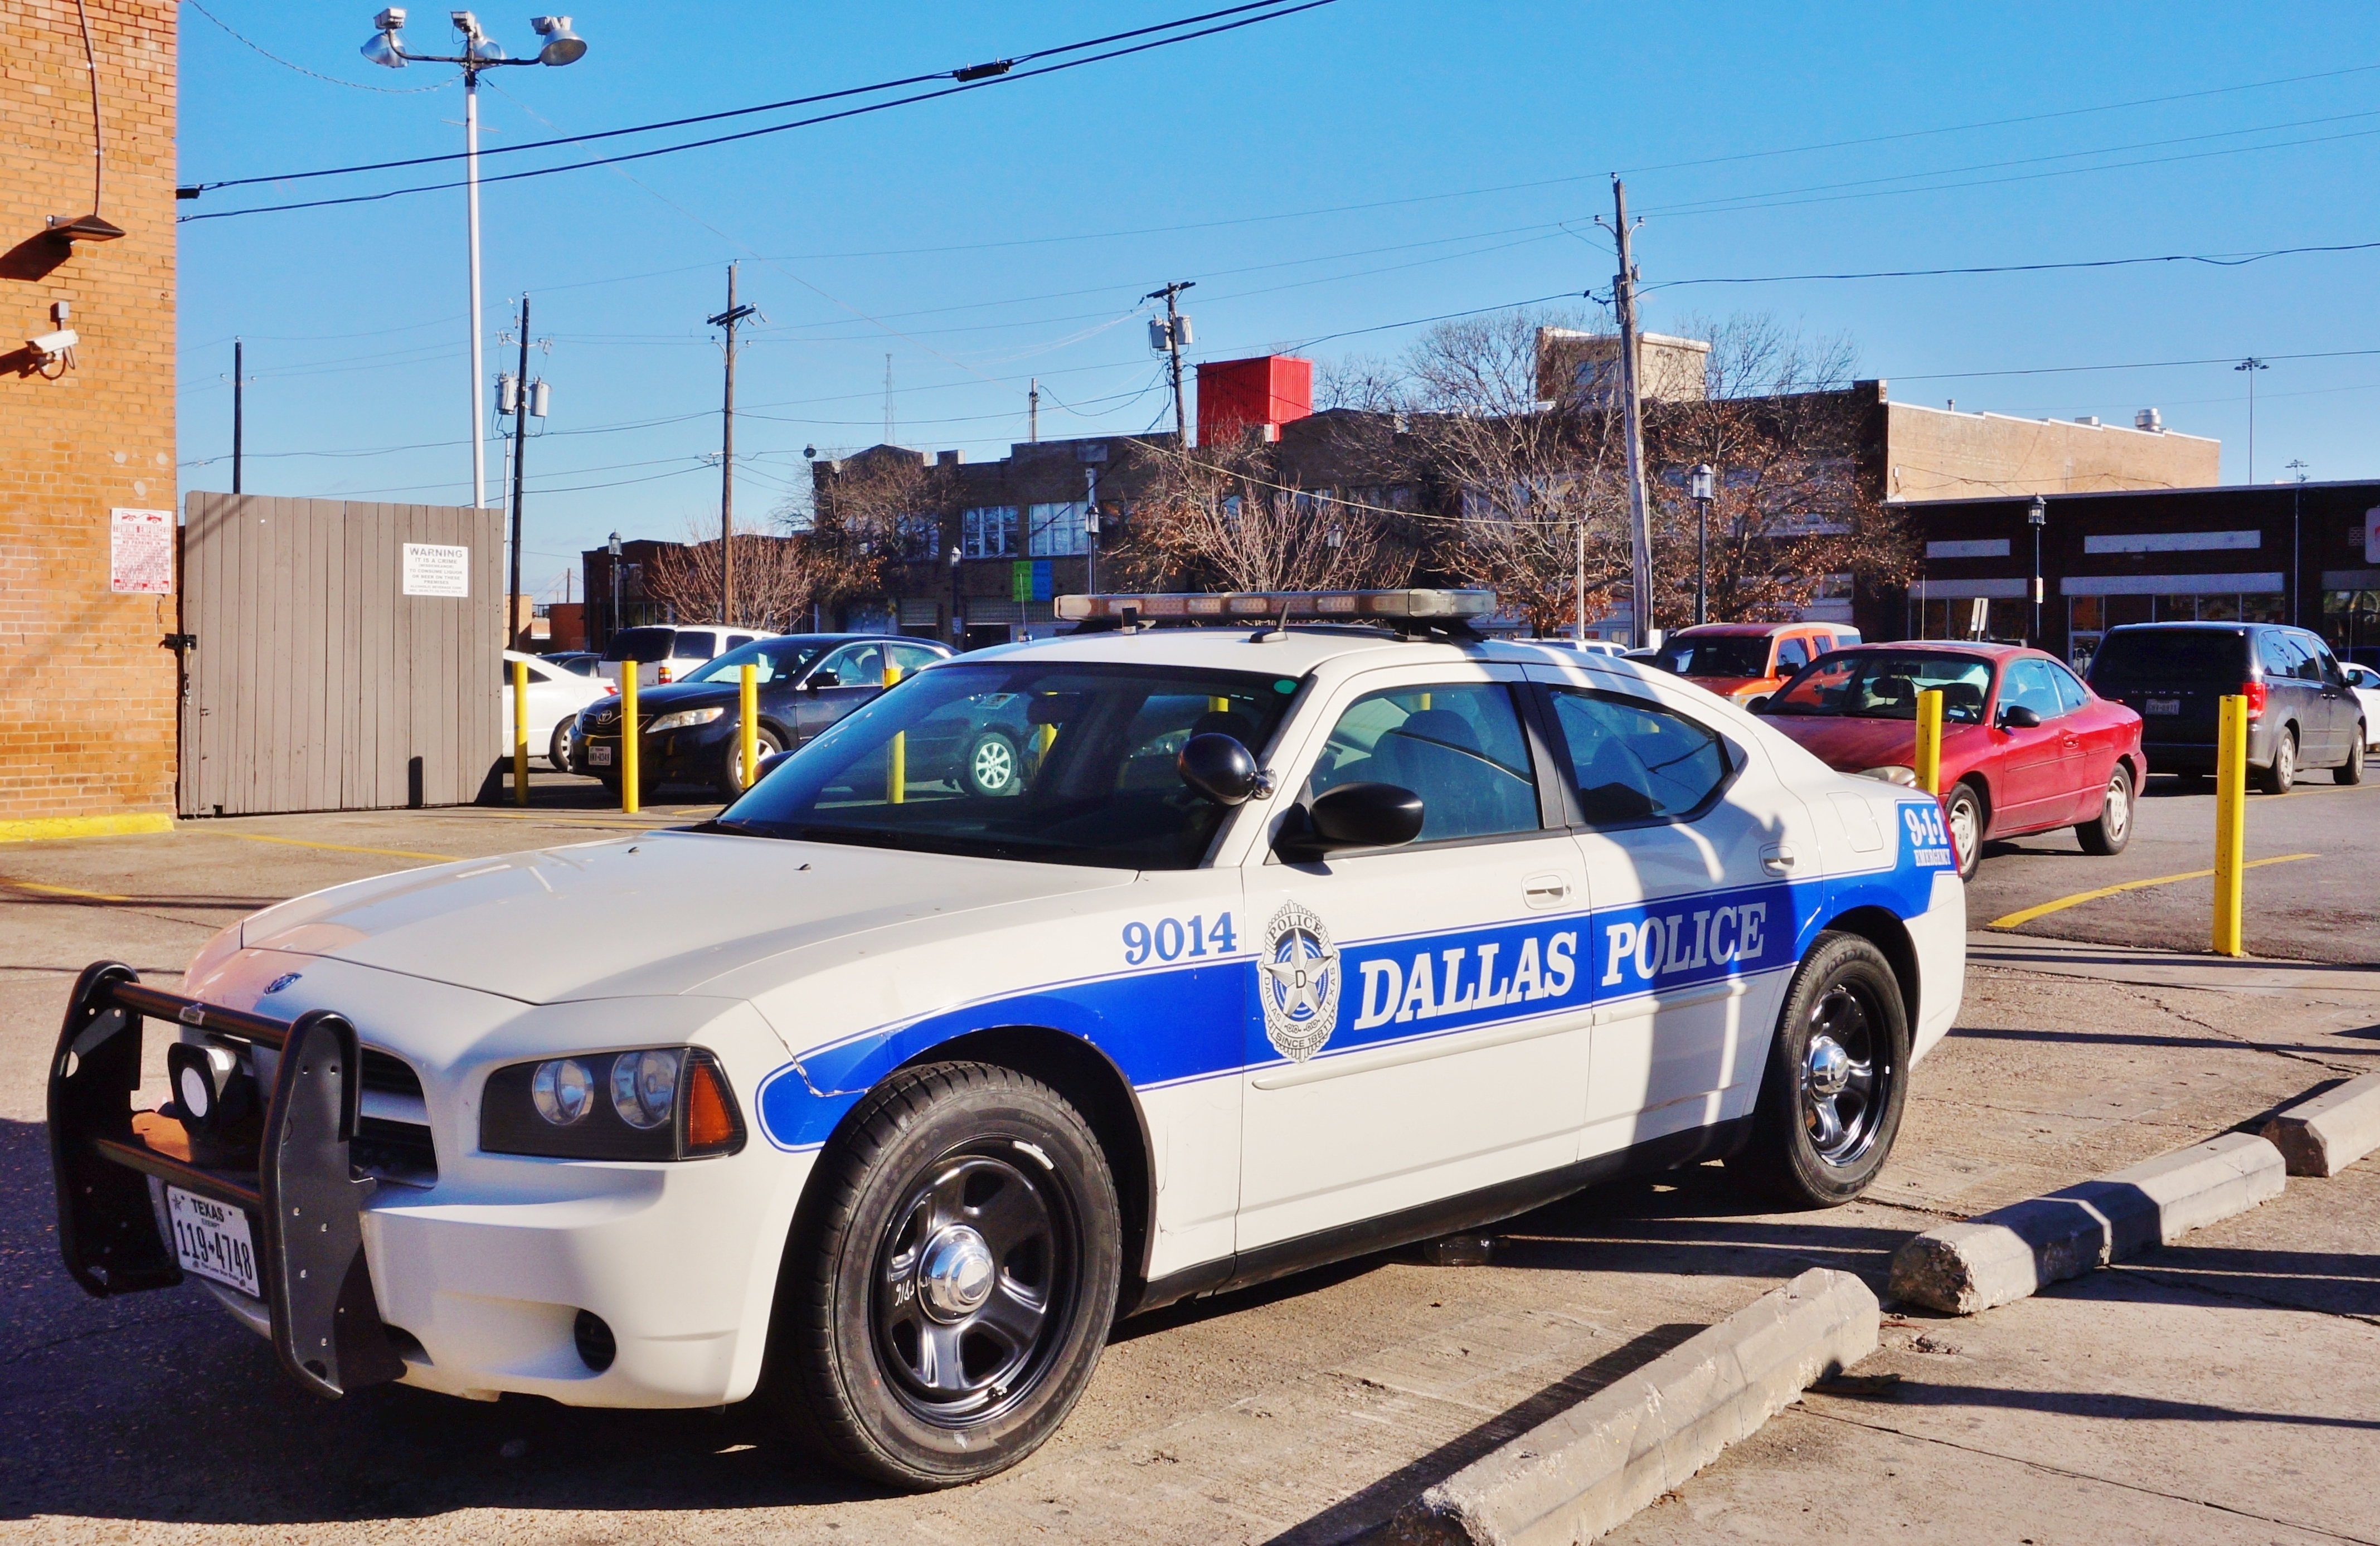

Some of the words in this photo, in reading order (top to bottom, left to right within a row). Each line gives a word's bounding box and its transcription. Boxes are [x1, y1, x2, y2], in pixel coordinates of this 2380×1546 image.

[113, 524, 137, 533] TOWING
[139, 526, 169, 534] ENFORCED
[410, 547, 463, 558] WARNING
[1913, 848, 1951, 867] EMERGENCY
[1122, 911, 1237, 966] 9014
[1268, 915, 1323, 941] POLICE
[1353, 932, 1577, 1030] DALLAS
[1601, 902, 1766, 986] POLICE
[1295, 970, 1306, 989] D
[1322, 966, 1335, 1013] TEXAS
[1265, 977, 1281, 1022] DALLAS
[1275, 1033, 1305, 1048] SINCE
[1308, 1026, 1329, 1045] 1881
[191, 1198, 224, 1223] TEXAS
